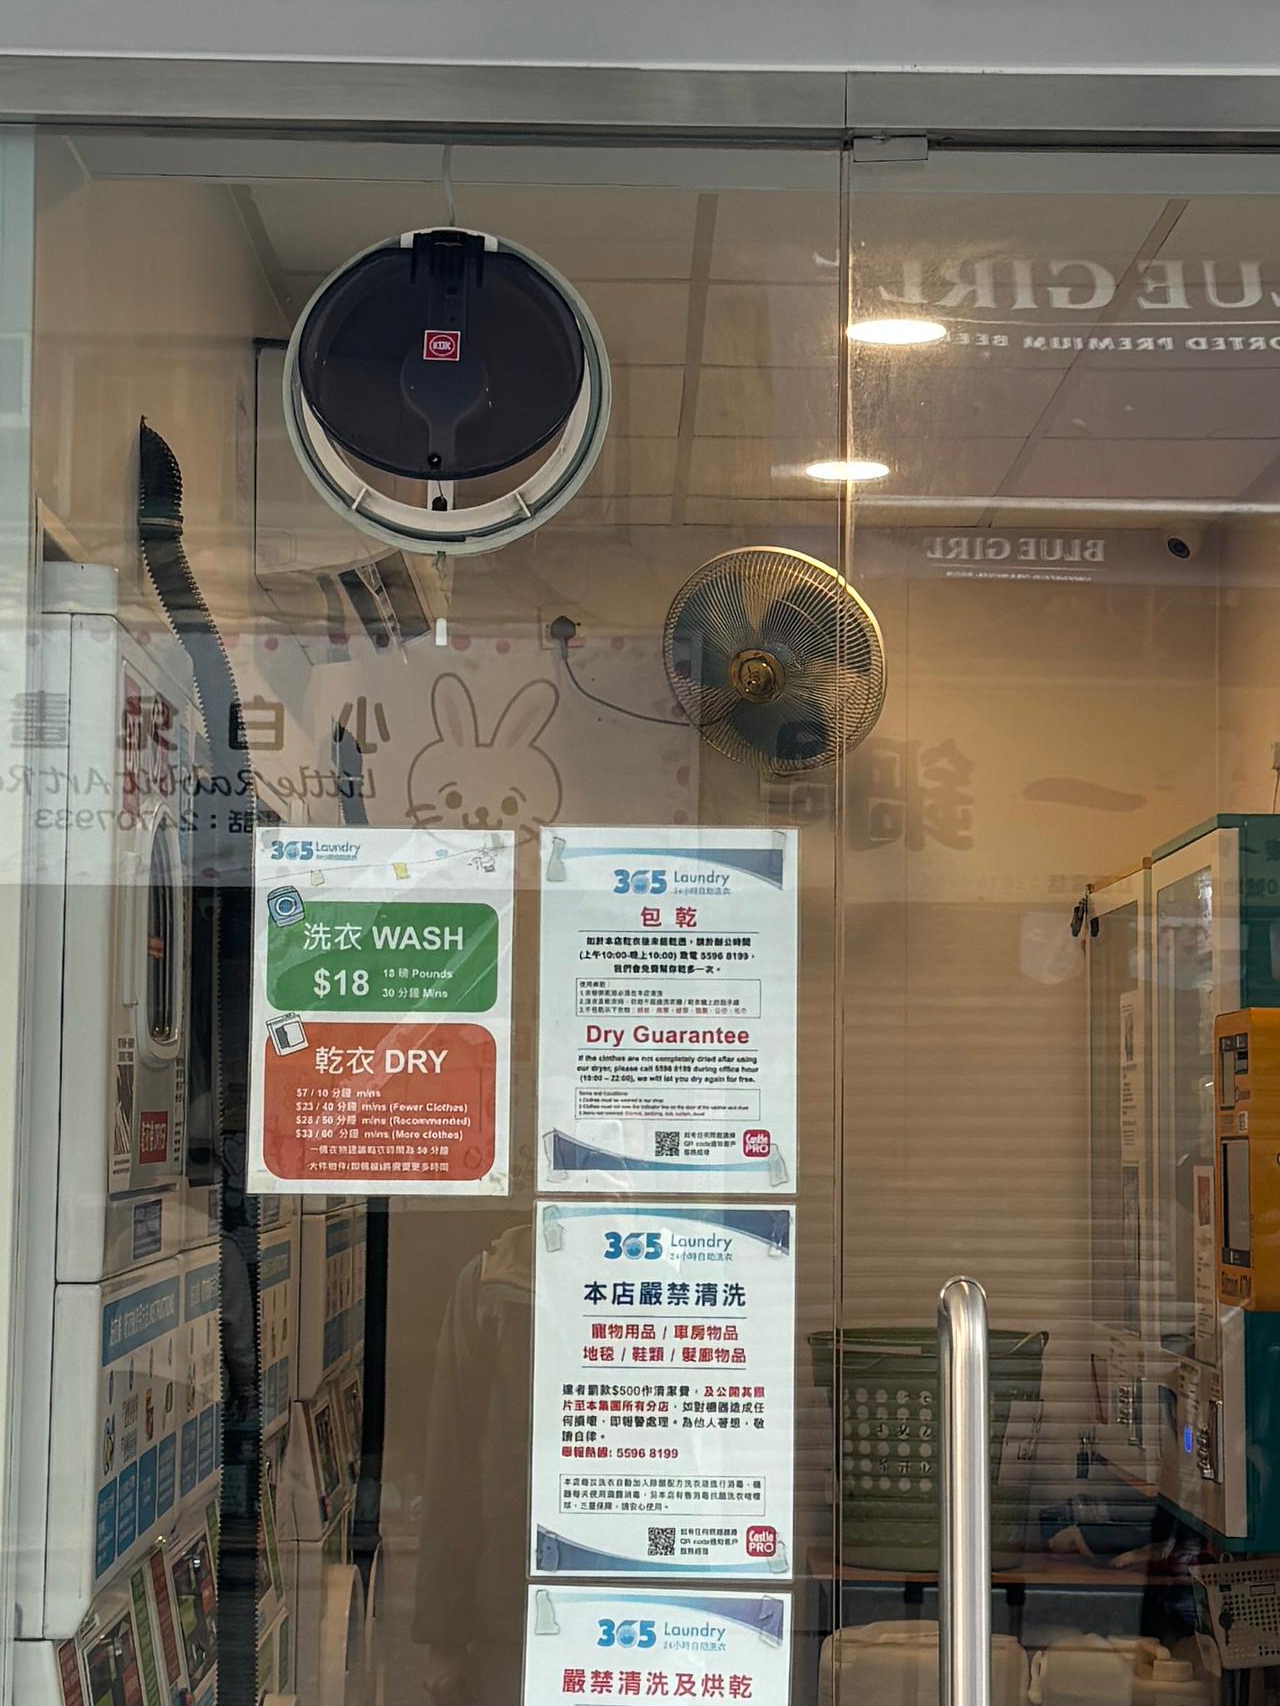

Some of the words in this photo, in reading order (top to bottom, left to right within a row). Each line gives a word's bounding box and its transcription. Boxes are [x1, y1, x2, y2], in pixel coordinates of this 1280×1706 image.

[270, 840, 314, 861] 365
[316, 841, 361, 856] Laundry
[613, 869, 668, 895] 365
[673, 870, 731, 887] Laundry
[303, 922, 362, 951] 洗衣
[372, 926, 464, 951] WASH
[314, 967, 370, 998] $18
[586, 1024, 625, 1049] Dry
[633, 1024, 750, 1046] Guarantee
[315, 1046, 375, 1076] 乾衣
[385, 1049, 448, 1075] DRY
[745, 1144, 770, 1154] PRO
[603, 1231, 663, 1261] 365
[670, 1233, 733, 1252] Laundry
[583, 1280, 747, 1307] 本店嚴禁清洗
[591, 1323, 656, 1341] 寵物用品
[583, 1345, 615, 1362] 地毯
[631, 1346, 665, 1363] 鞋類
[616, 1448, 646, 1459] 5596
[649, 1448, 679, 1460] 8199
[749, 1540, 775, 1554] PRO
[597, 1618, 657, 1649] 365
[664, 1621, 726, 1641] Laundry
[562, 1668, 754, 1700] 嚴禁清洗及烘乾
